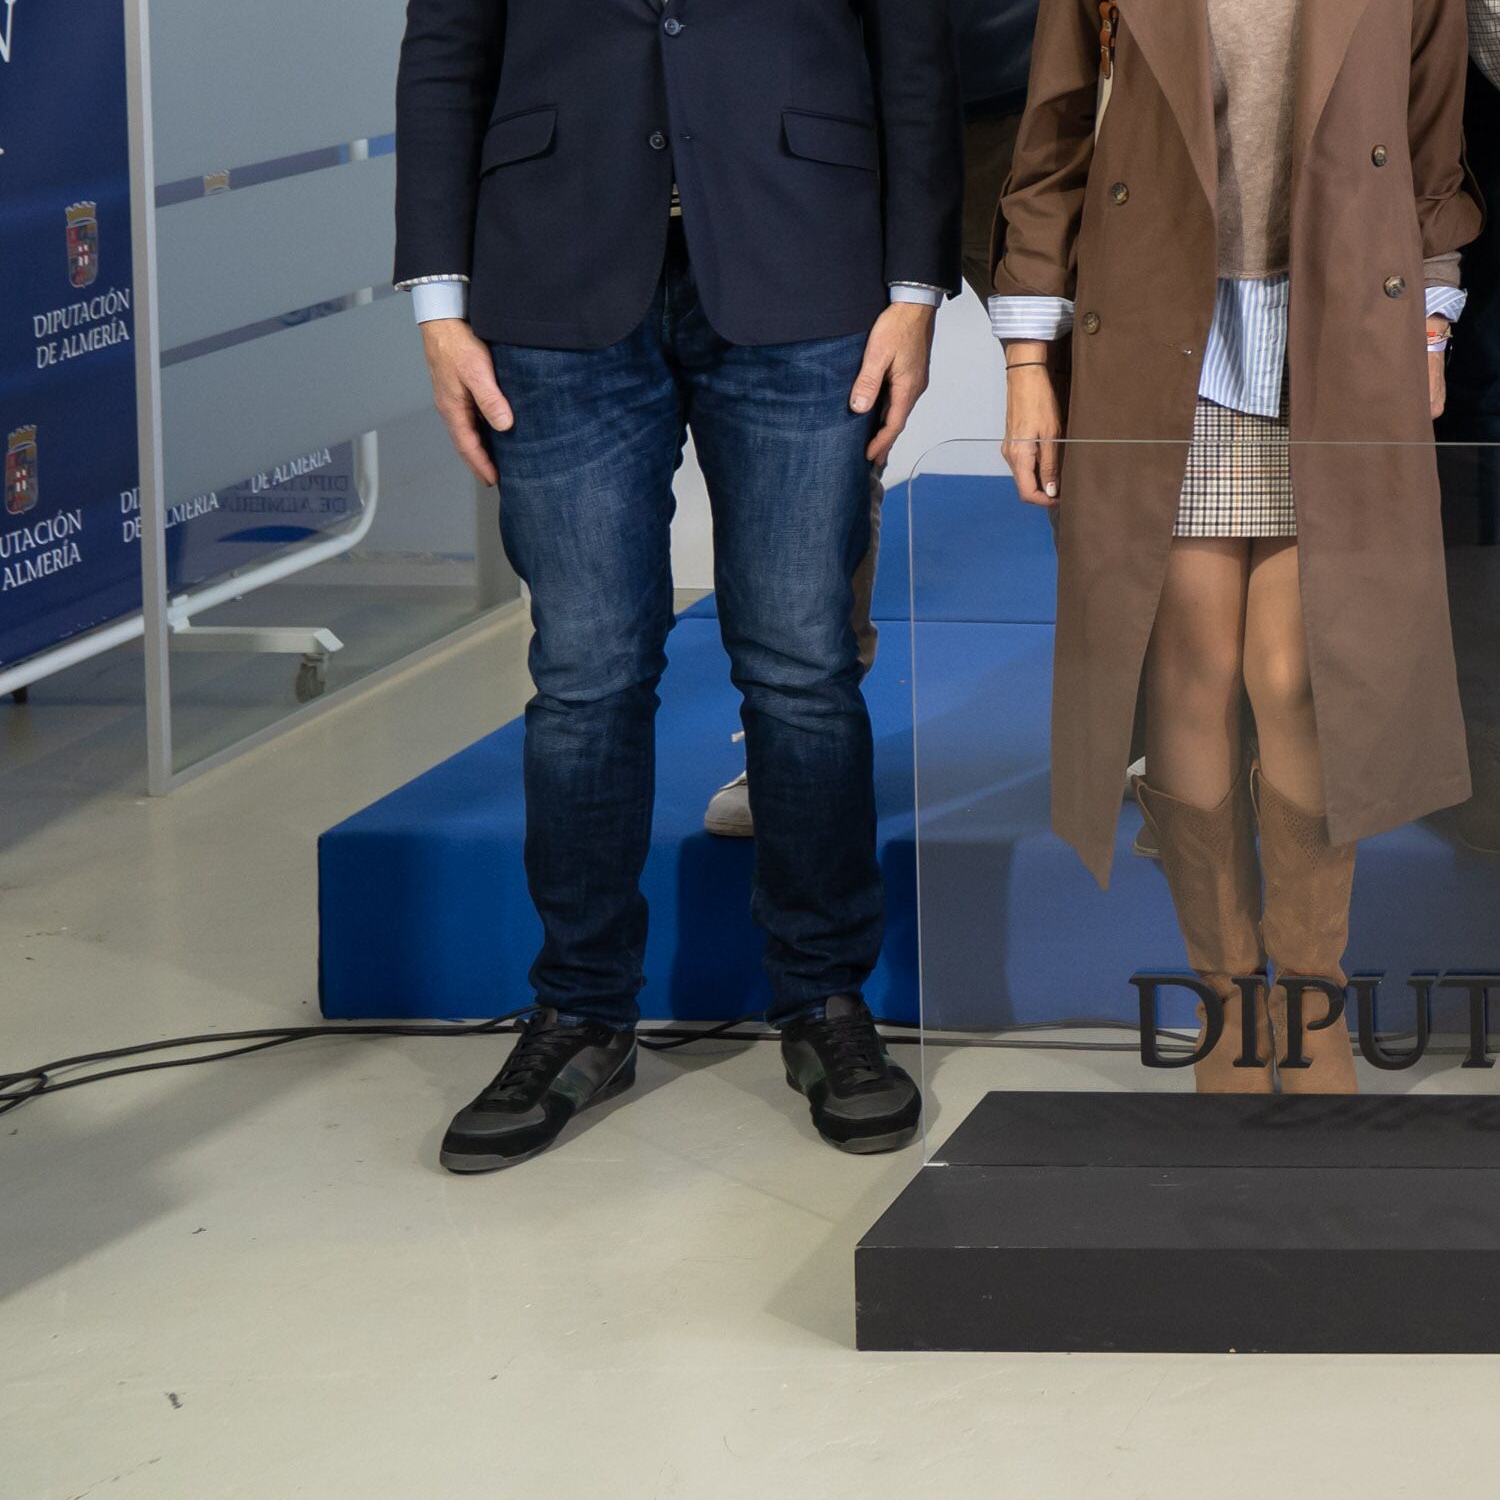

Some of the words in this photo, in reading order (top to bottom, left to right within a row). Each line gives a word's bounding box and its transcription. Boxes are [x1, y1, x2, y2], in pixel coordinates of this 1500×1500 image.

[33, 287, 131, 339] DIPUTACIÓN
[37, 346, 57, 368] DE
[60, 319, 130, 362] ALMERÍA
[0, 508, 83, 558] UTACIÓN
[2, 540, 82, 591] ALMERÍA
